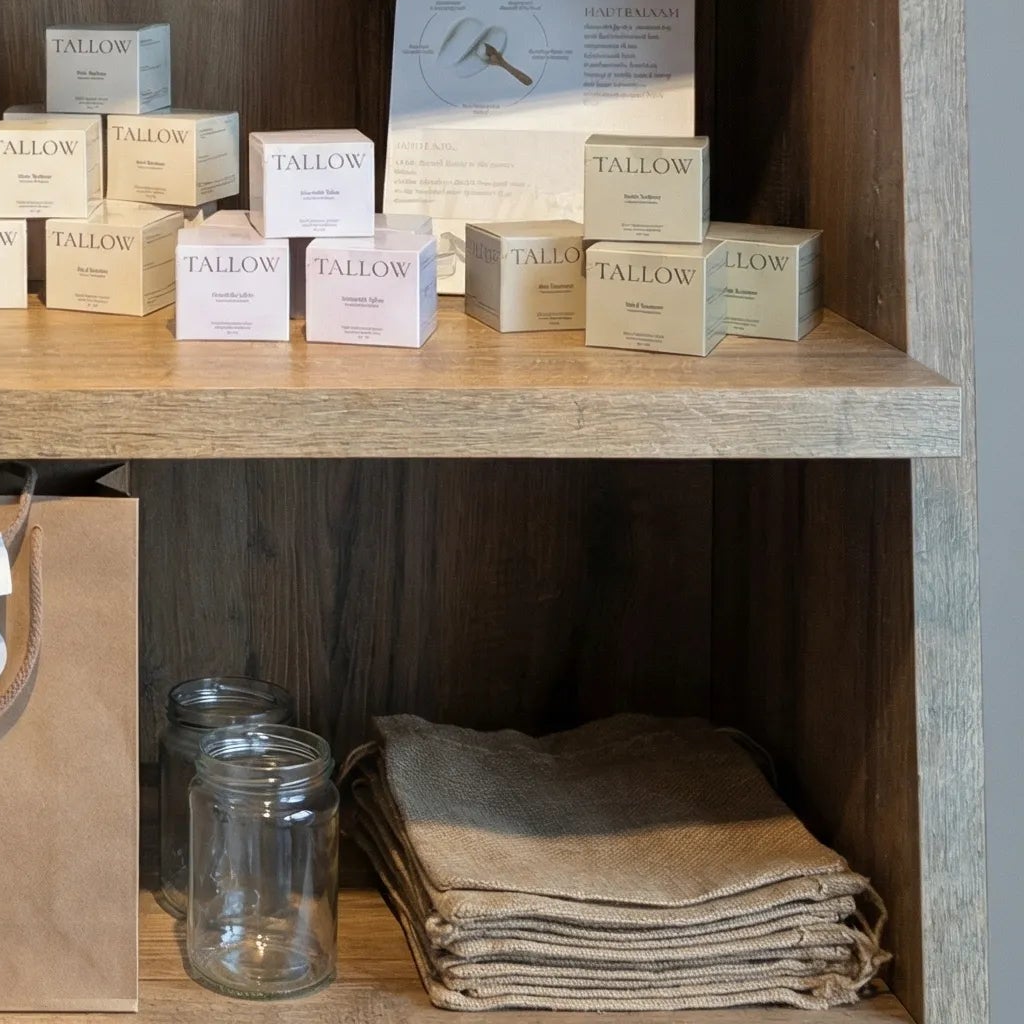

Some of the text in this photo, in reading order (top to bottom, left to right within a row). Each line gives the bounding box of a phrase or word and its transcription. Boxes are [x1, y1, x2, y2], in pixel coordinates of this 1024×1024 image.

[52, 39, 132, 54] TALLOW
[112, 125, 189, 144] TALLOW
[272, 153, 366, 170] TALLOW
[592, 157, 693, 175] TALLOW
[52, 231, 135, 251] TALLOW
[183, 256, 280, 273] TALLOW
[510, 246, 581, 265] TALLO
[725, 251, 789, 272] LLOW
[314, 258, 412, 279] TALLOW
[595, 262, 696, 286] TALLOW
